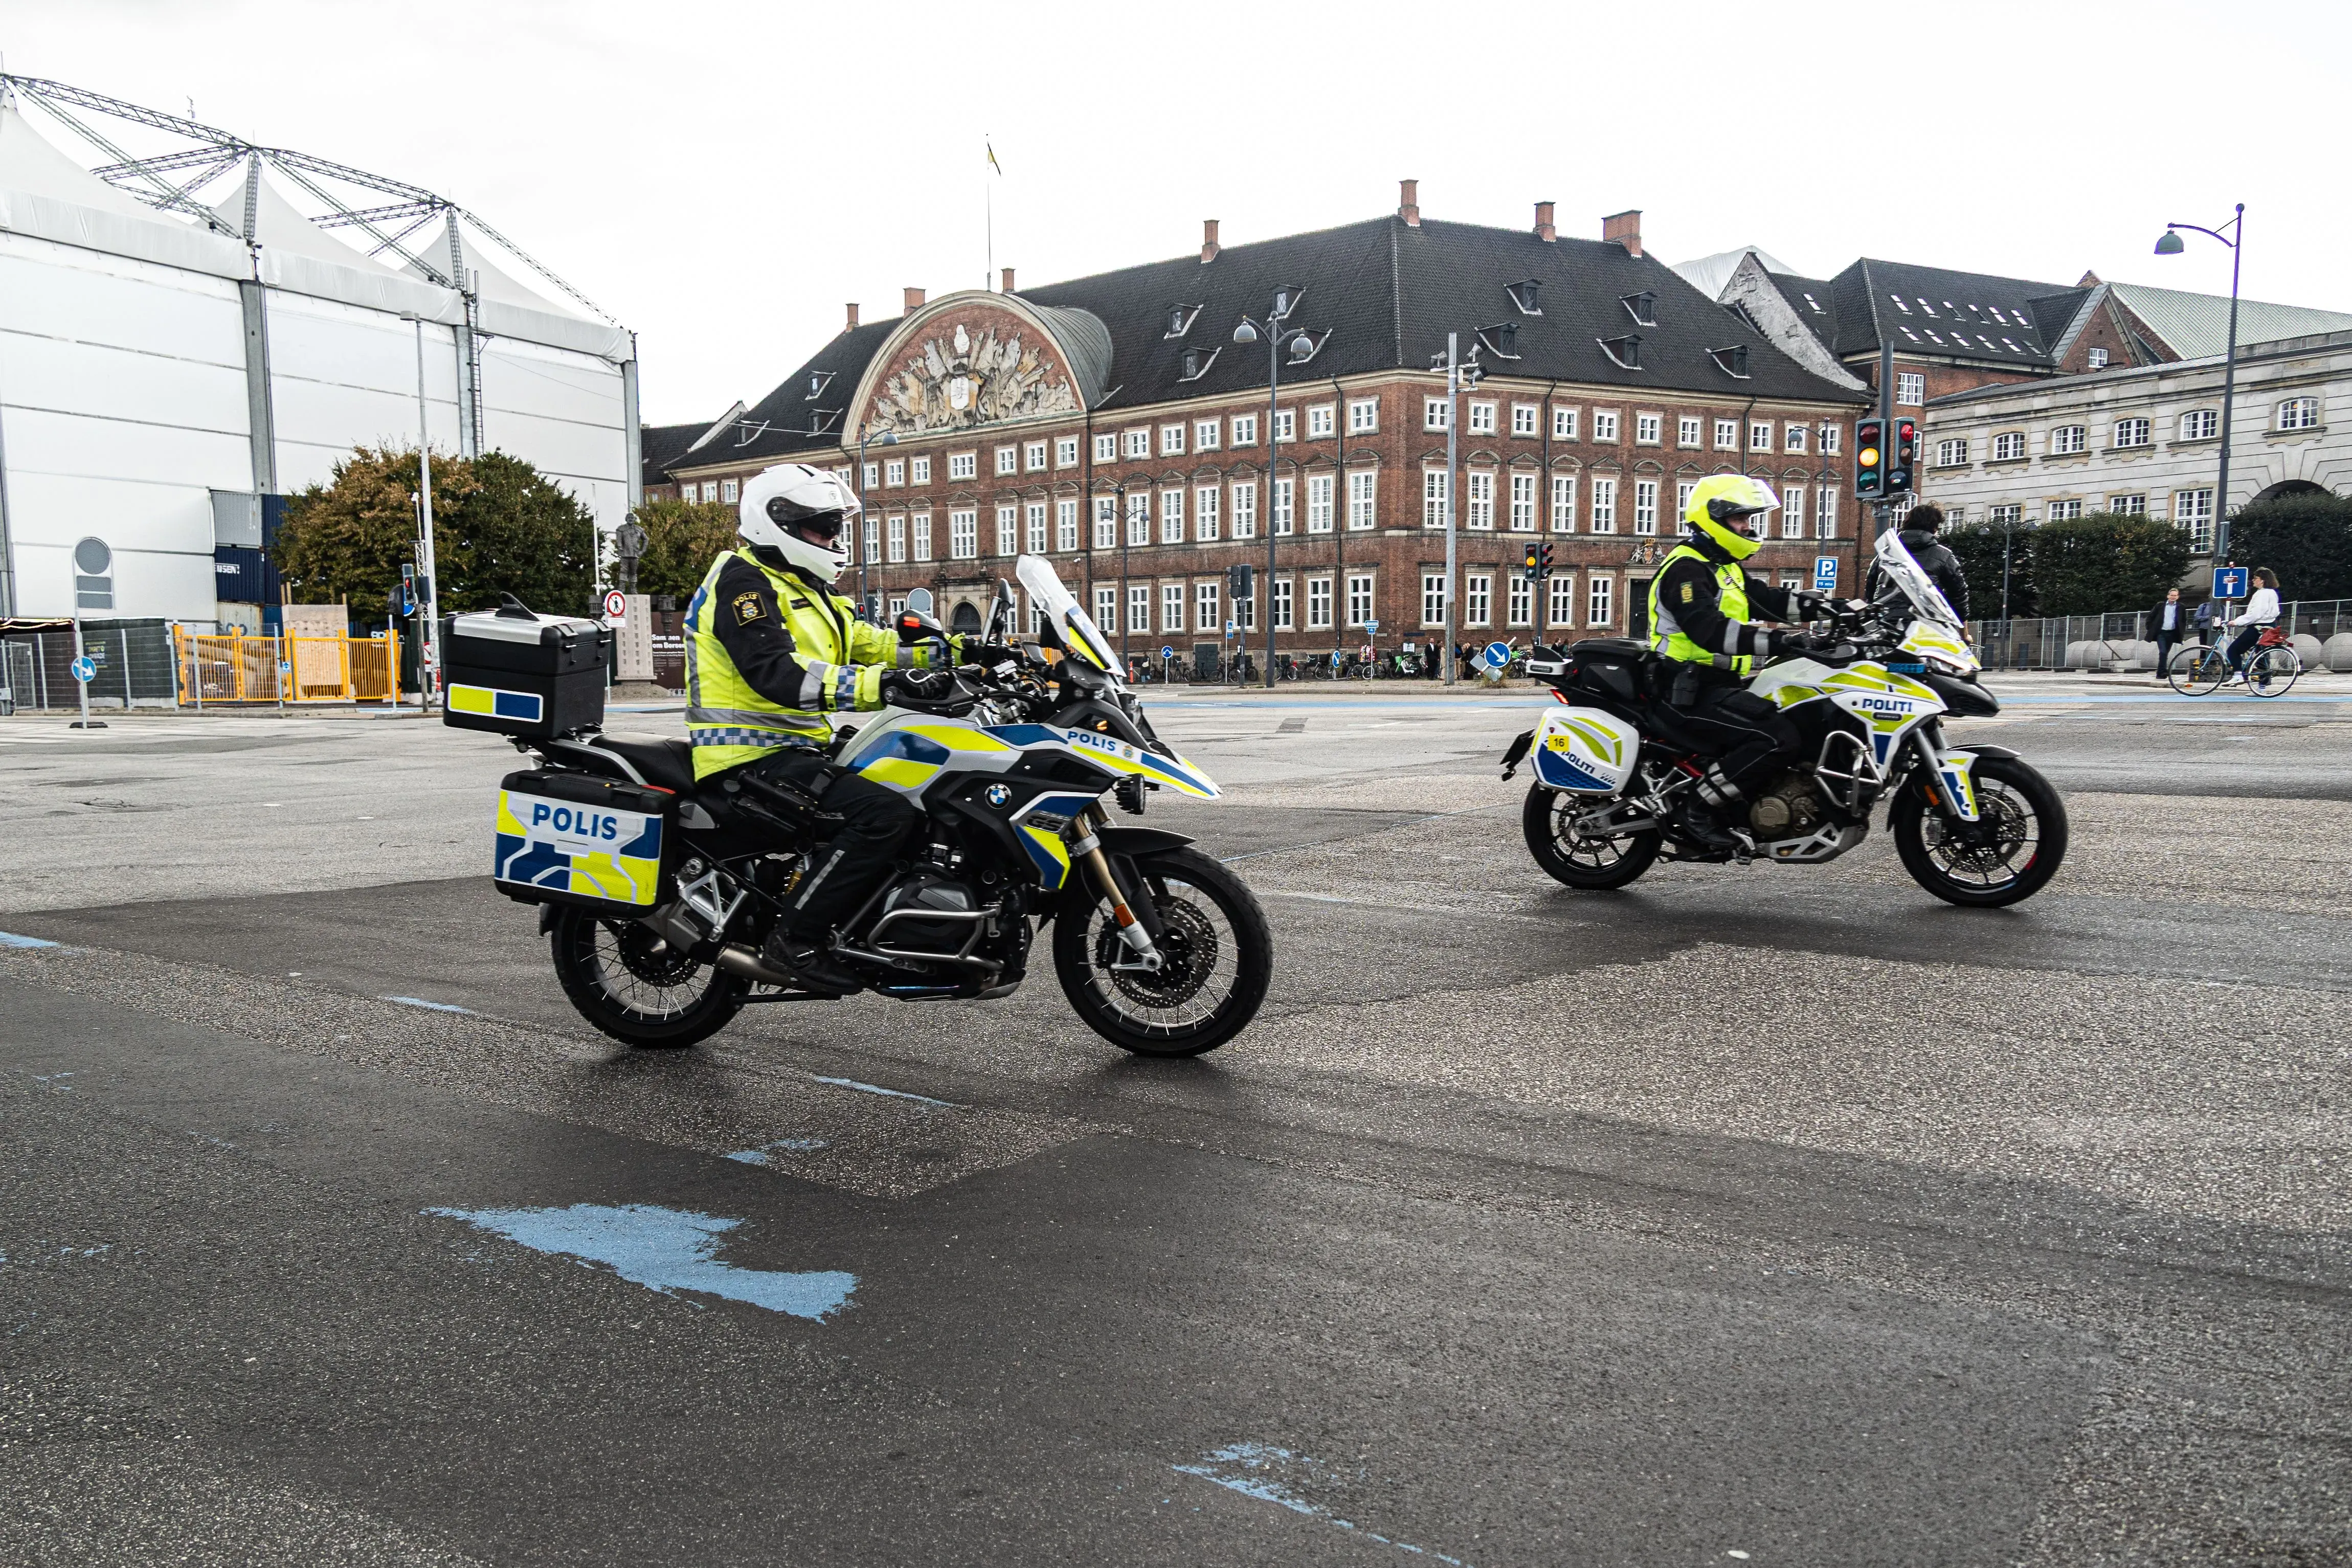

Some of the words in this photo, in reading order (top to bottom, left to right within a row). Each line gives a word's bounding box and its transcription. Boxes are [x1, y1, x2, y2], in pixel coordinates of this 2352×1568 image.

[1821, 561, 1833, 576] P
[733, 593, 758, 607] POLIS
[1862, 698, 1912, 712] POLITI
[1068, 731, 1116, 751] POLIS
[1554, 738, 1564, 747] 16
[532, 803, 617, 840] POLIS
